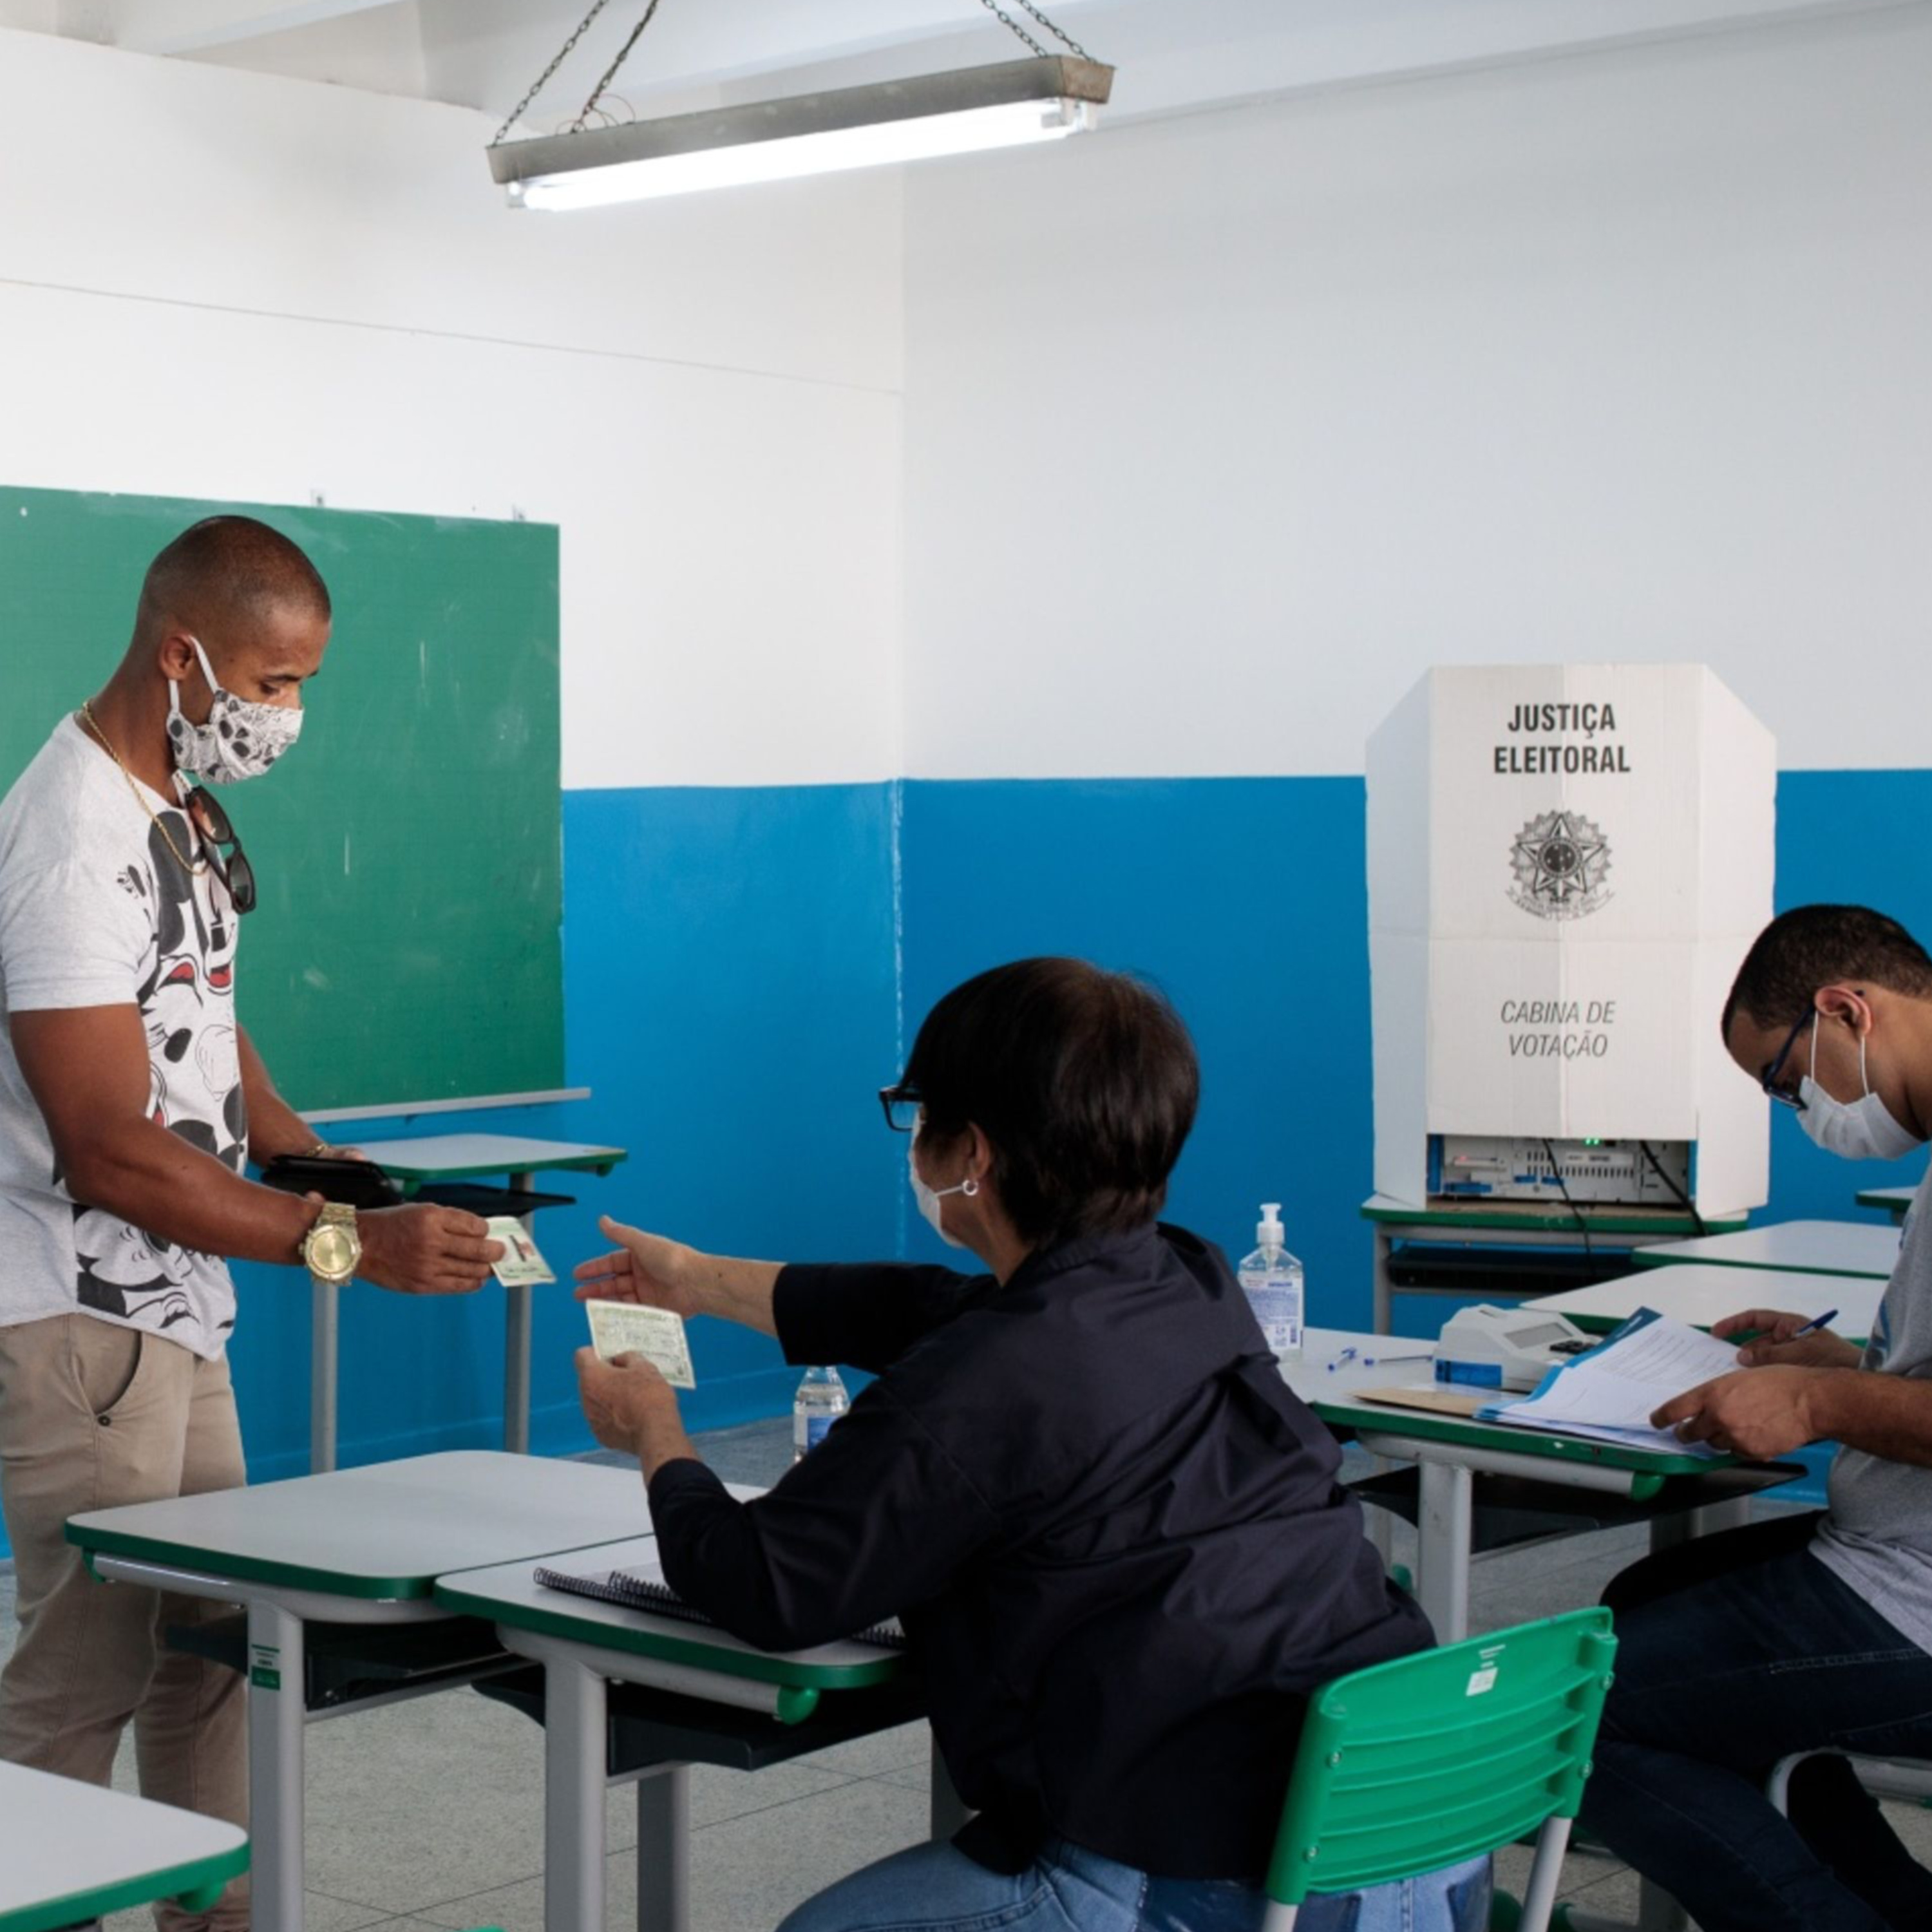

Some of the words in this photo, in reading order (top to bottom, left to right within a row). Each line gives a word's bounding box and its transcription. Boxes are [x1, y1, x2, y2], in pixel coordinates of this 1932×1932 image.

[1507, 703, 1616, 739] JUSTIÇA
[1493, 745, 1632, 774] ELEITORAL
[1500, 999, 1579, 1025] CABINA
[1586, 1000, 1616, 1025] DE
[1508, 1029, 1609, 1061] VOTAÇÃO
